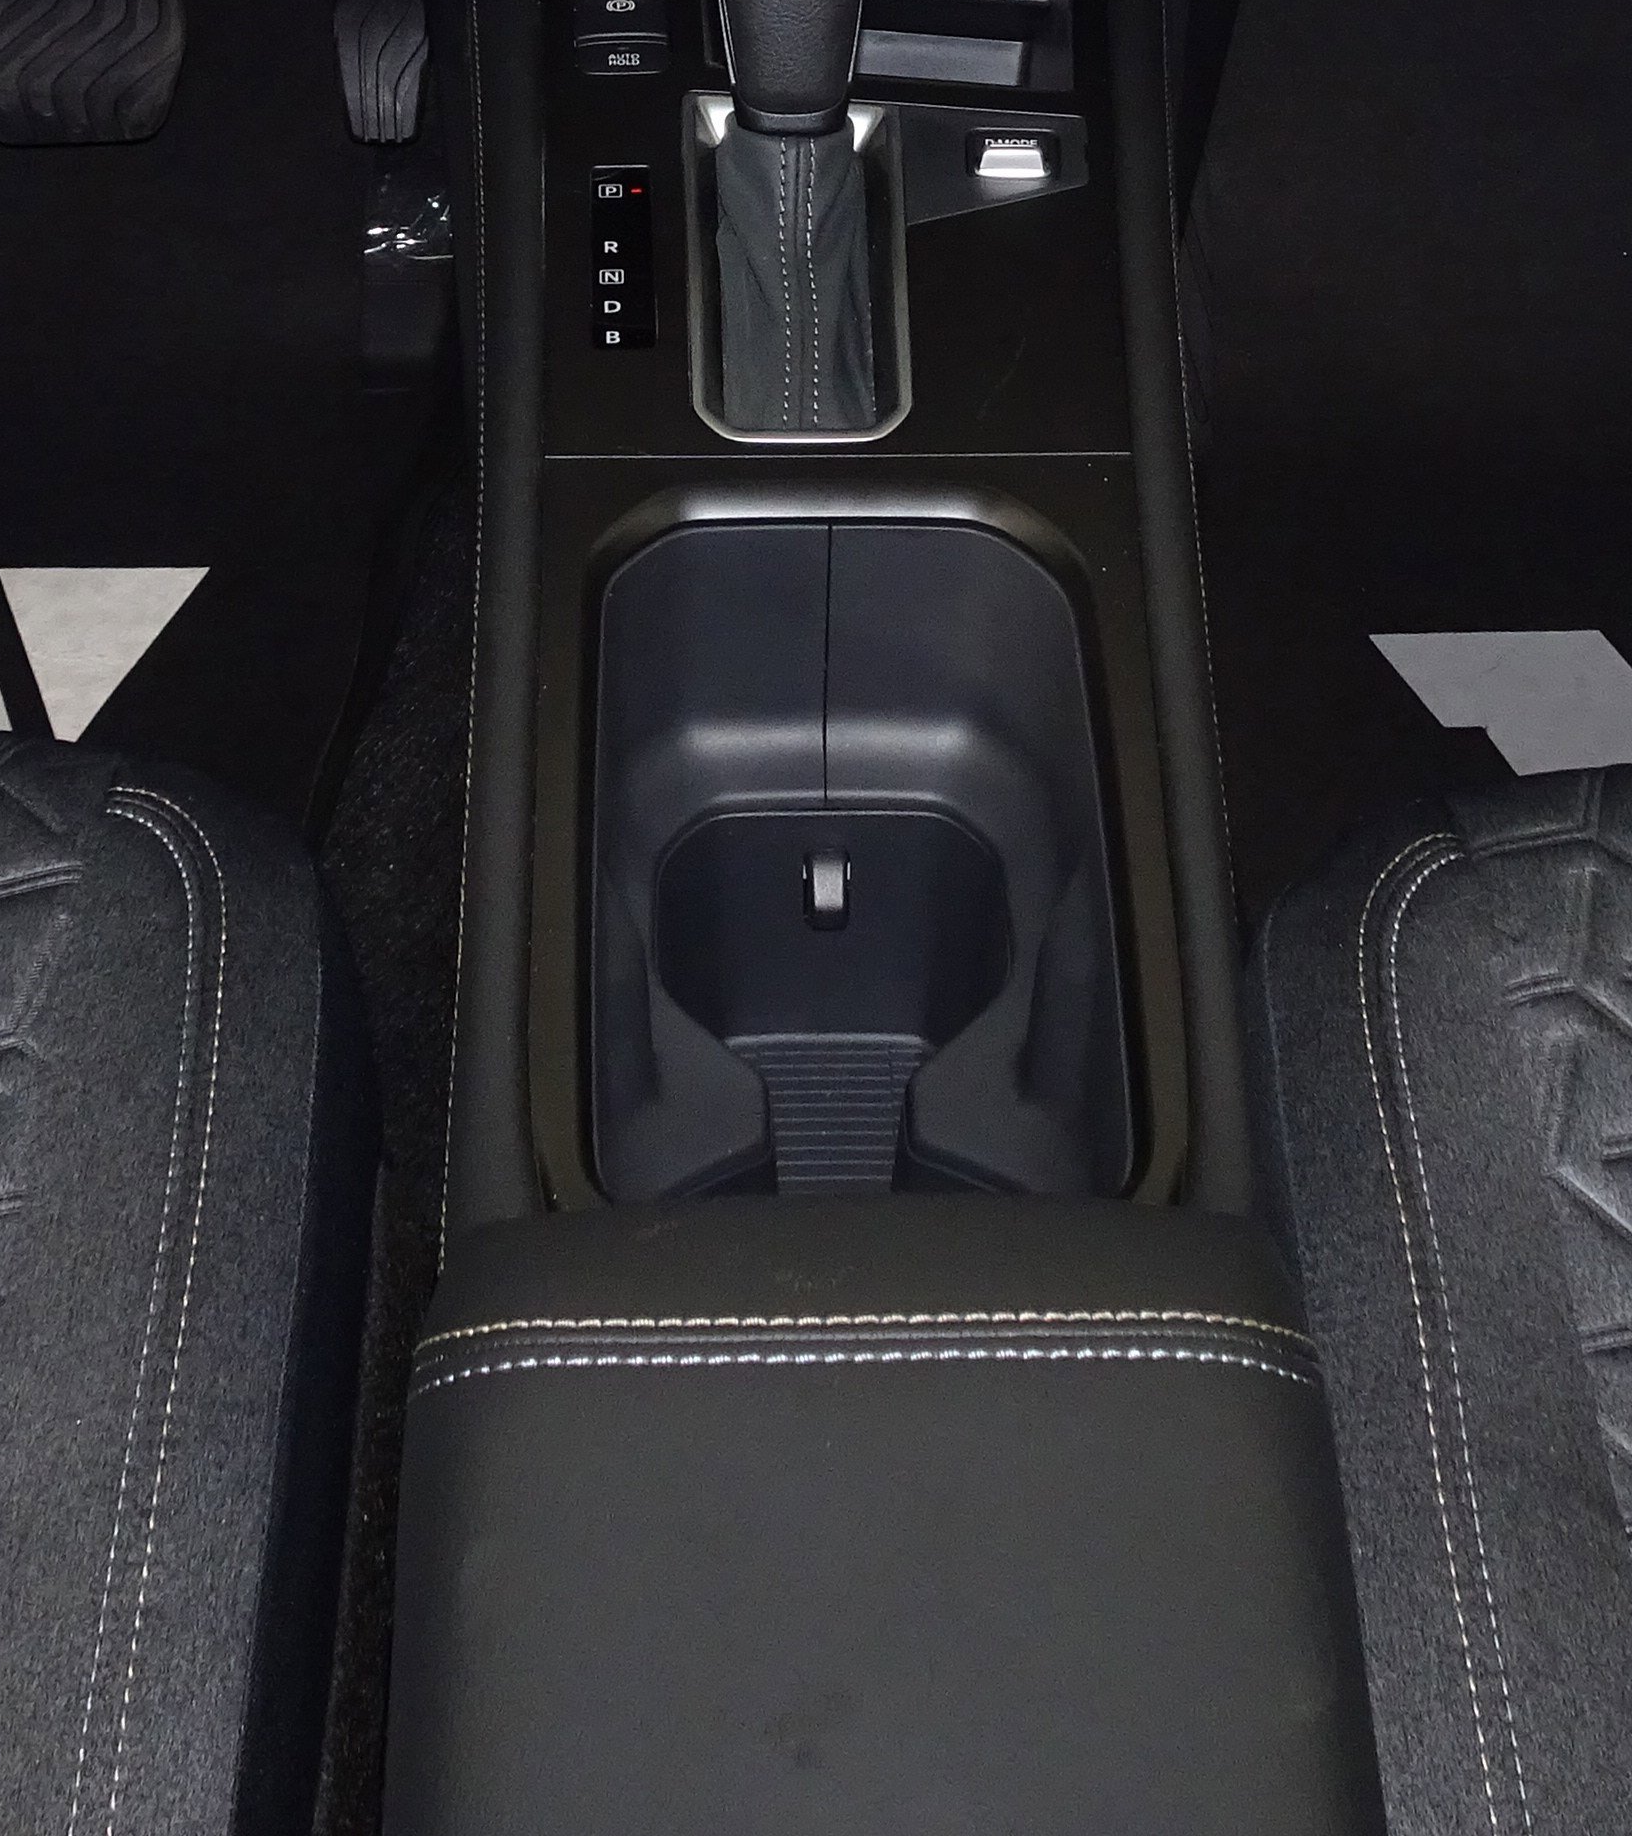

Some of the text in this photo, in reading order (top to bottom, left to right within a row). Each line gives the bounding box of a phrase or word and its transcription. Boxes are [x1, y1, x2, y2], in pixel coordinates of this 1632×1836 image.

[605, 186, 617, 196] P
[604, 240, 618, 253] R
[604, 270, 619, 283] N
[604, 300, 621, 313] D
[605, 330, 621, 344] B
